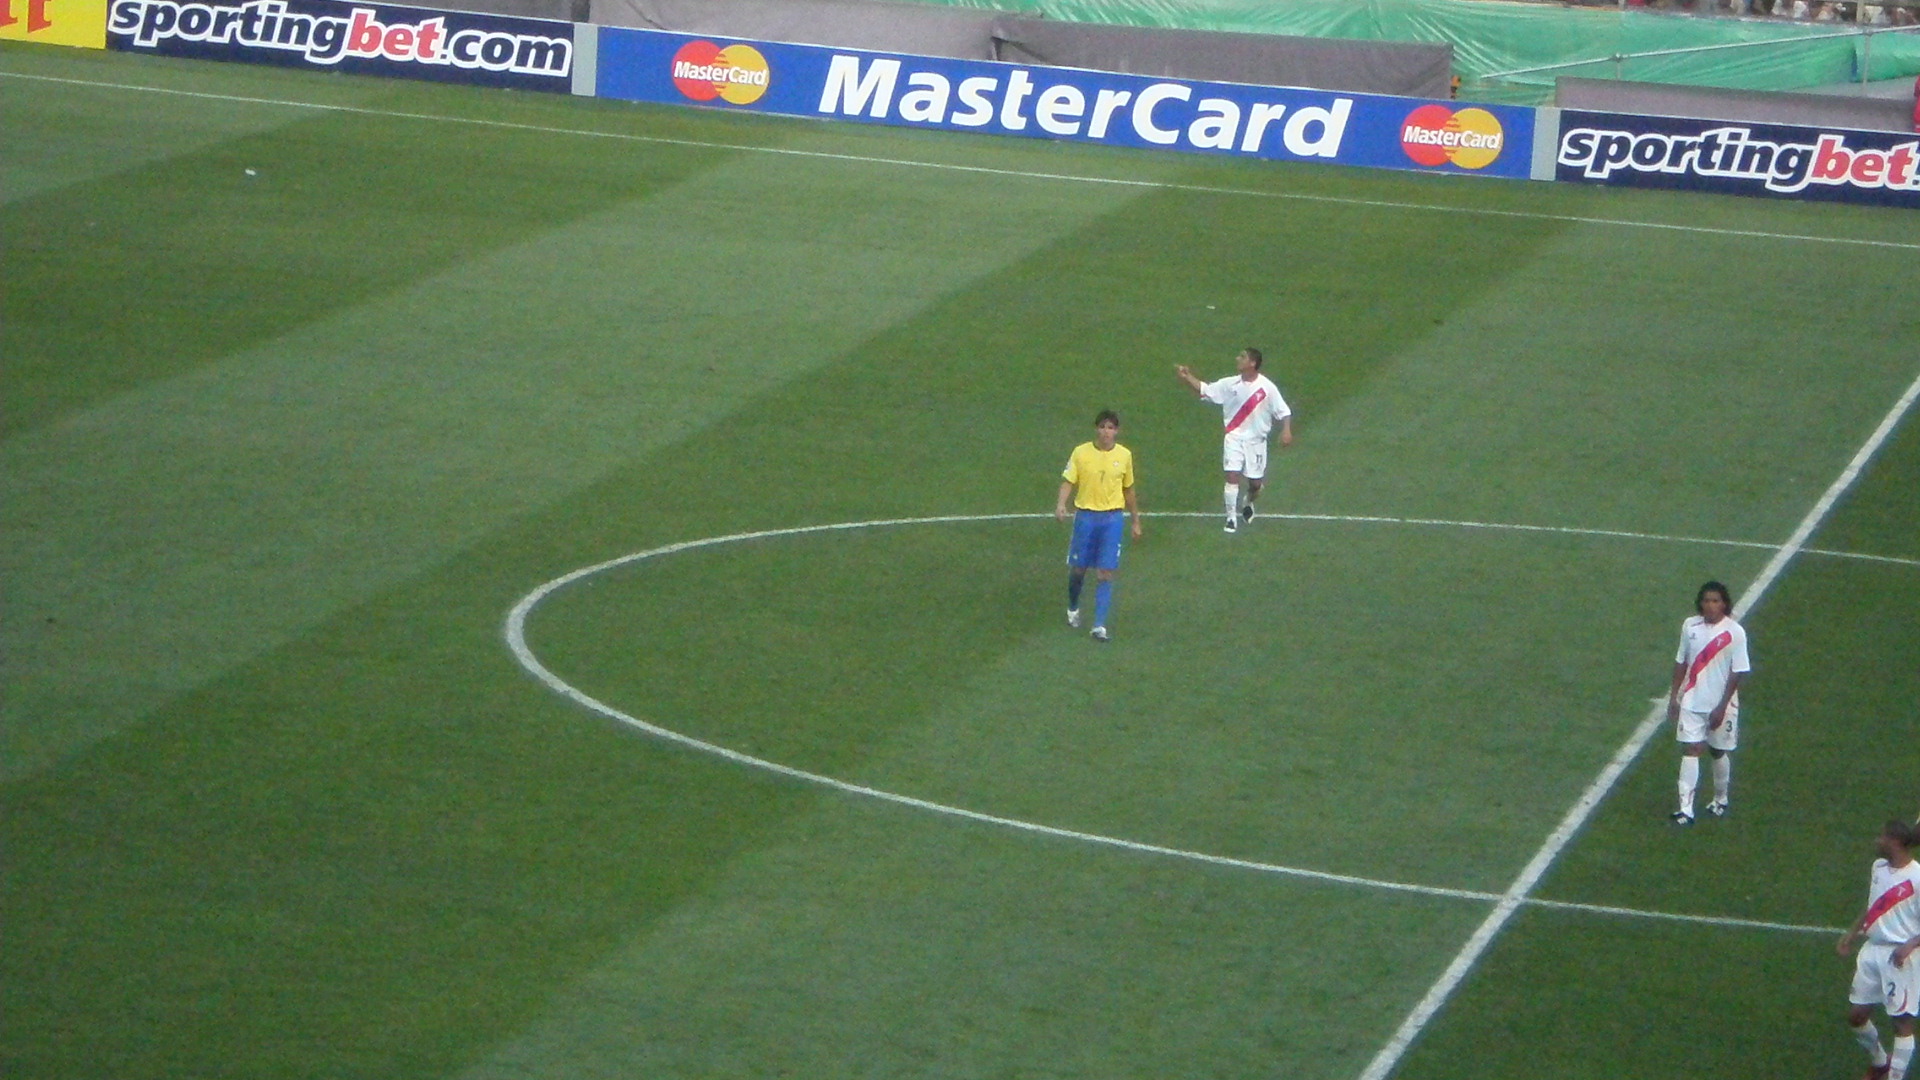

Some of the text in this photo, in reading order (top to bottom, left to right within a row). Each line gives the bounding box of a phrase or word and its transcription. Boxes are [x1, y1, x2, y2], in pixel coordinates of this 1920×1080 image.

[107, 0, 571, 76] sportingbet.com
[674, 60, 768, 86] MasterCard
[817, 54, 1353, 159] MasterCard
[1403, 125, 1501, 149] MasterCard
[1557, 126, 1920, 192] sportingbet.
[1098, 470, 1106, 484] 7
[1725, 720, 1733, 733] 3
[1887, 981, 1896, 997] 2
